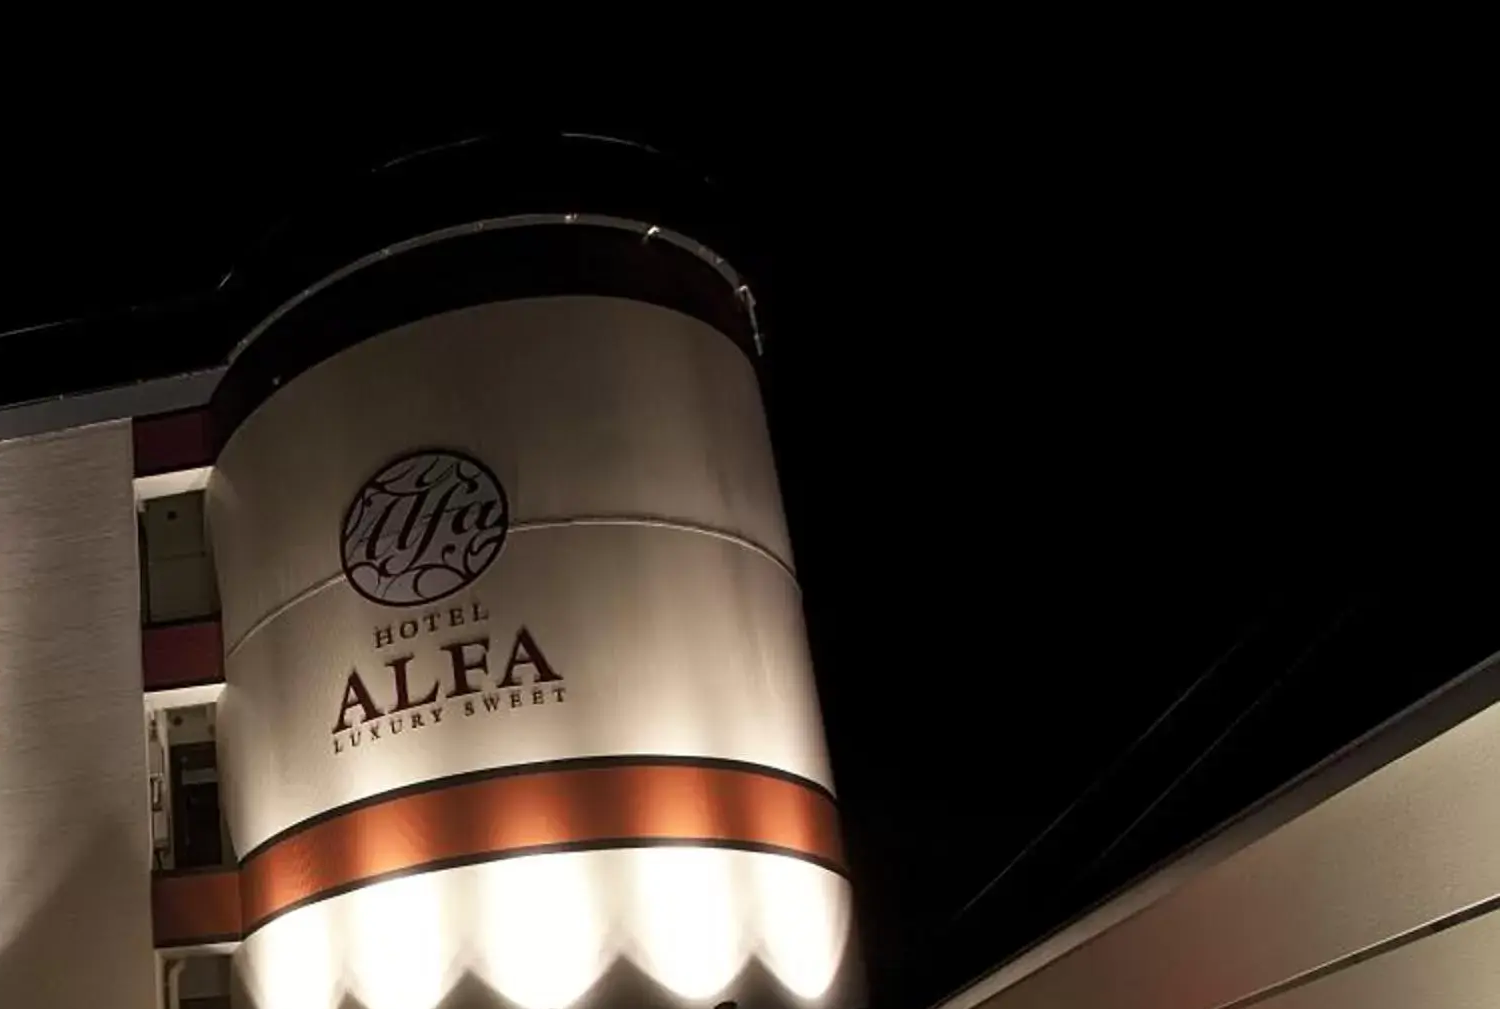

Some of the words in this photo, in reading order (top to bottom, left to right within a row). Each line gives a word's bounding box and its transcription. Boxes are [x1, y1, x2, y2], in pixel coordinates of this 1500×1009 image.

[374, 602, 490, 648] HOTEL
[331, 624, 565, 735] ALFA
[332, 707, 444, 755] LUXURY
[463, 687, 567, 718] SWEET
